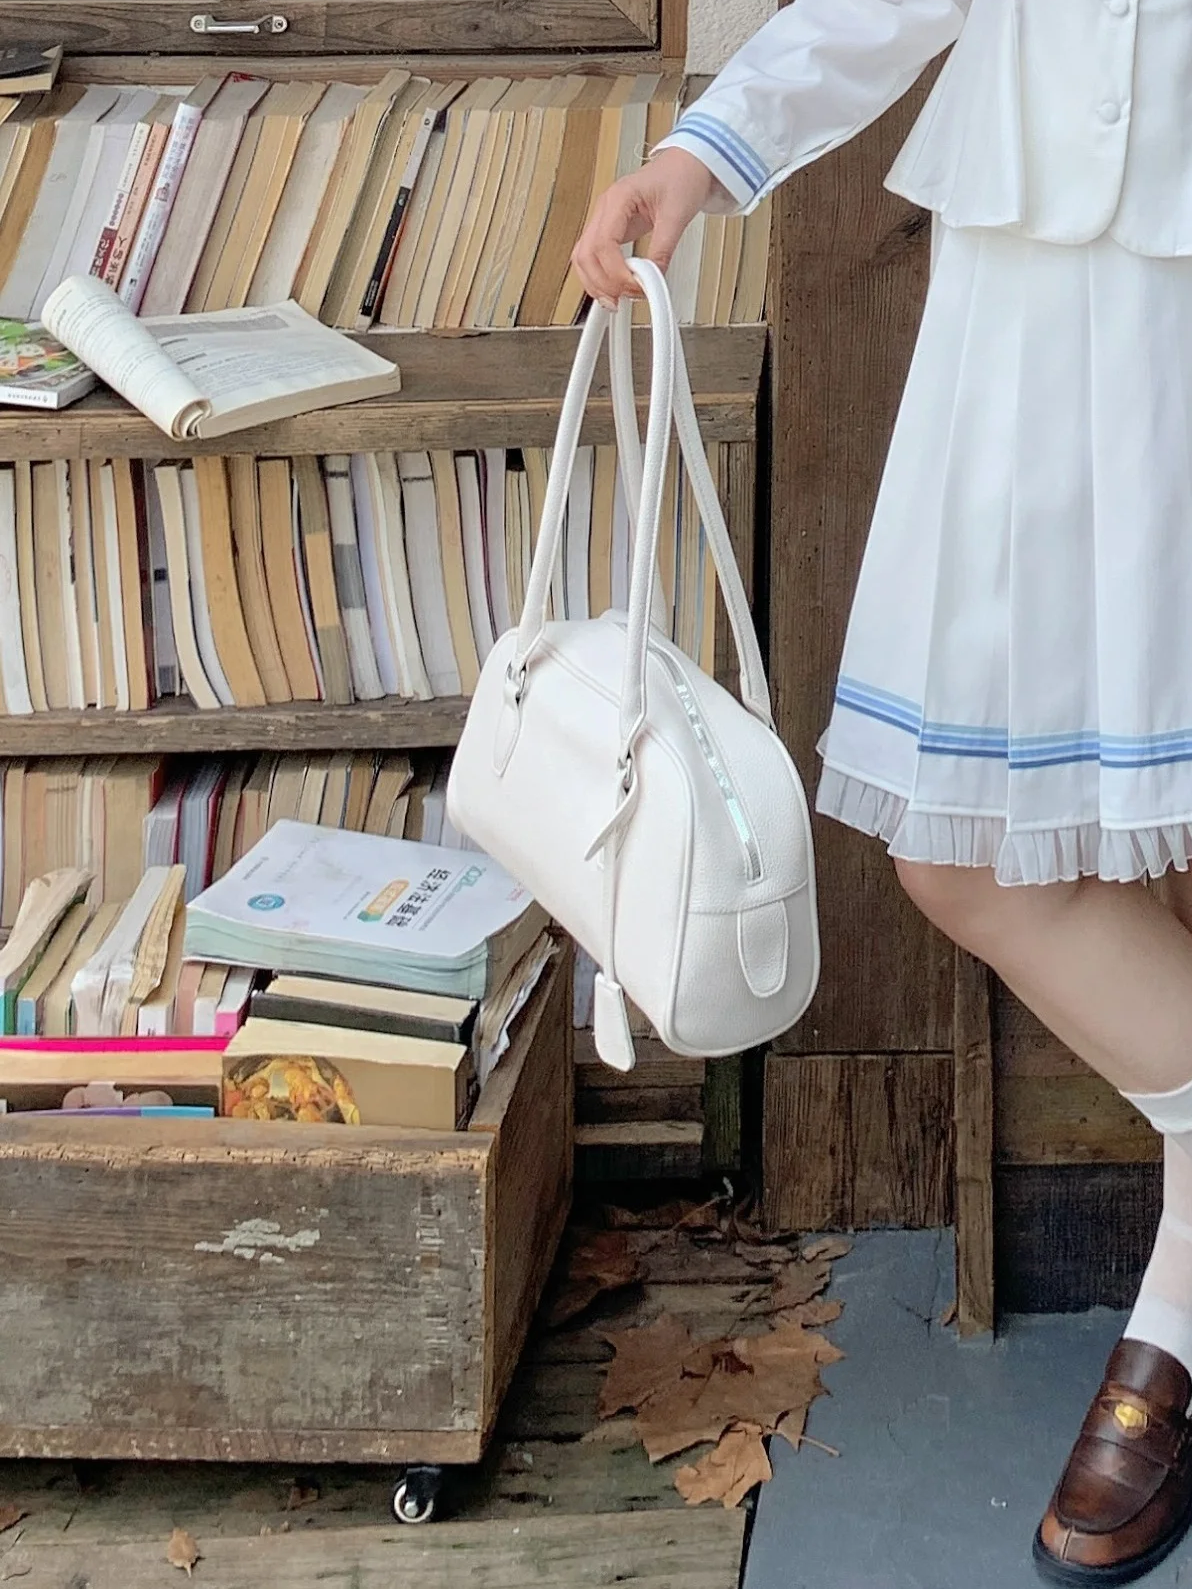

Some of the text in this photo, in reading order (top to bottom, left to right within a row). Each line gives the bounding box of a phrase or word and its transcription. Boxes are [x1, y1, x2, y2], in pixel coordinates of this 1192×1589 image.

[385, 868, 452, 927] 经济法基础
